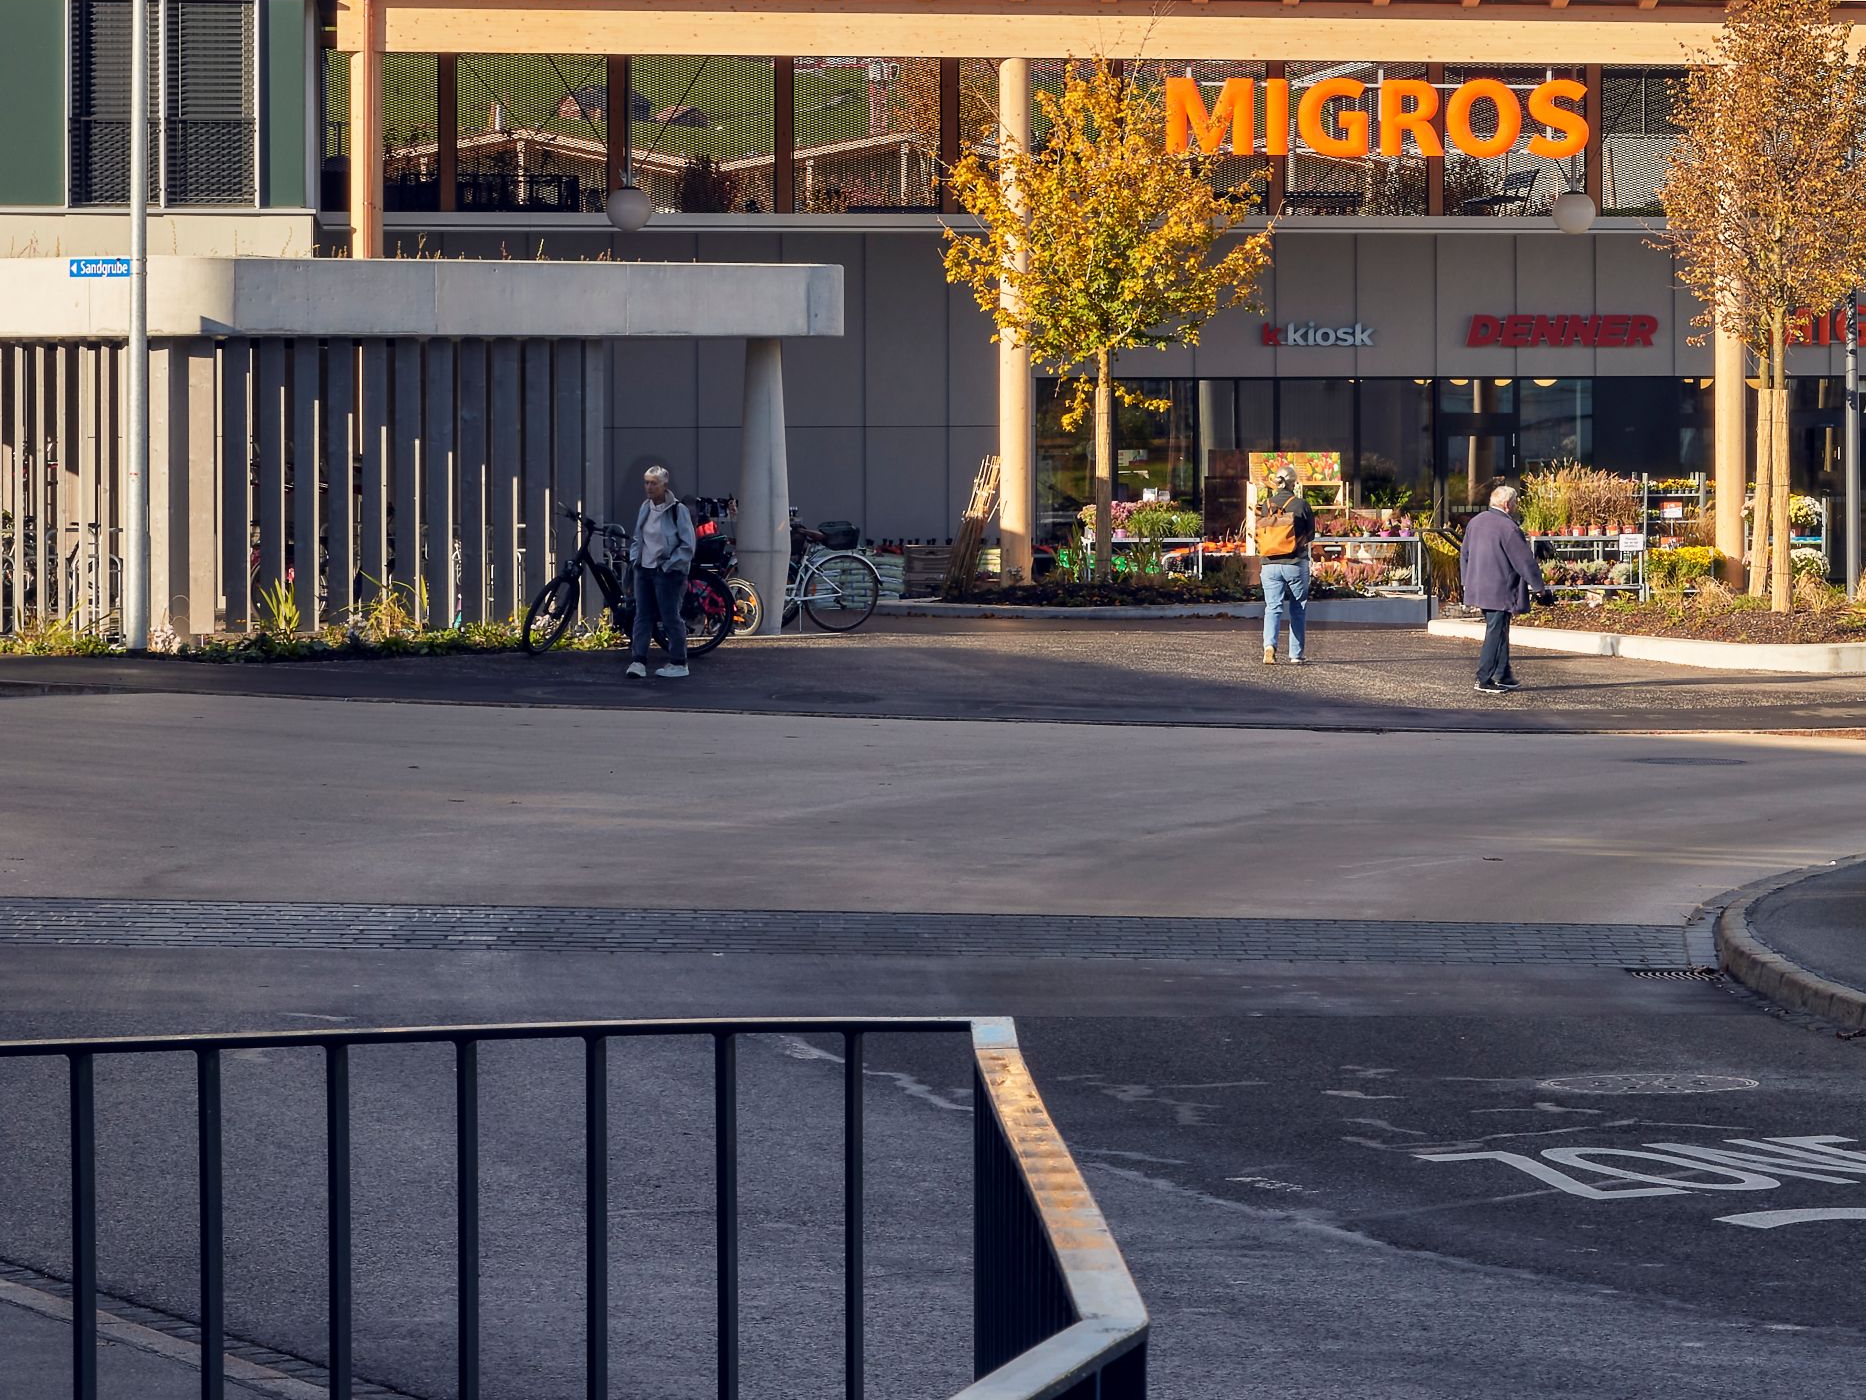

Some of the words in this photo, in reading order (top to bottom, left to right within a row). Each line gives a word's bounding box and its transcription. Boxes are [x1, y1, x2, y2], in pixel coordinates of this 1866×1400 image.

[1165, 76, 1590, 159] MIGROS
[80, 260, 129, 278] Sandgrube
[1287, 320, 1376, 346] kiosk
[1465, 313, 1659, 348] DENNER
